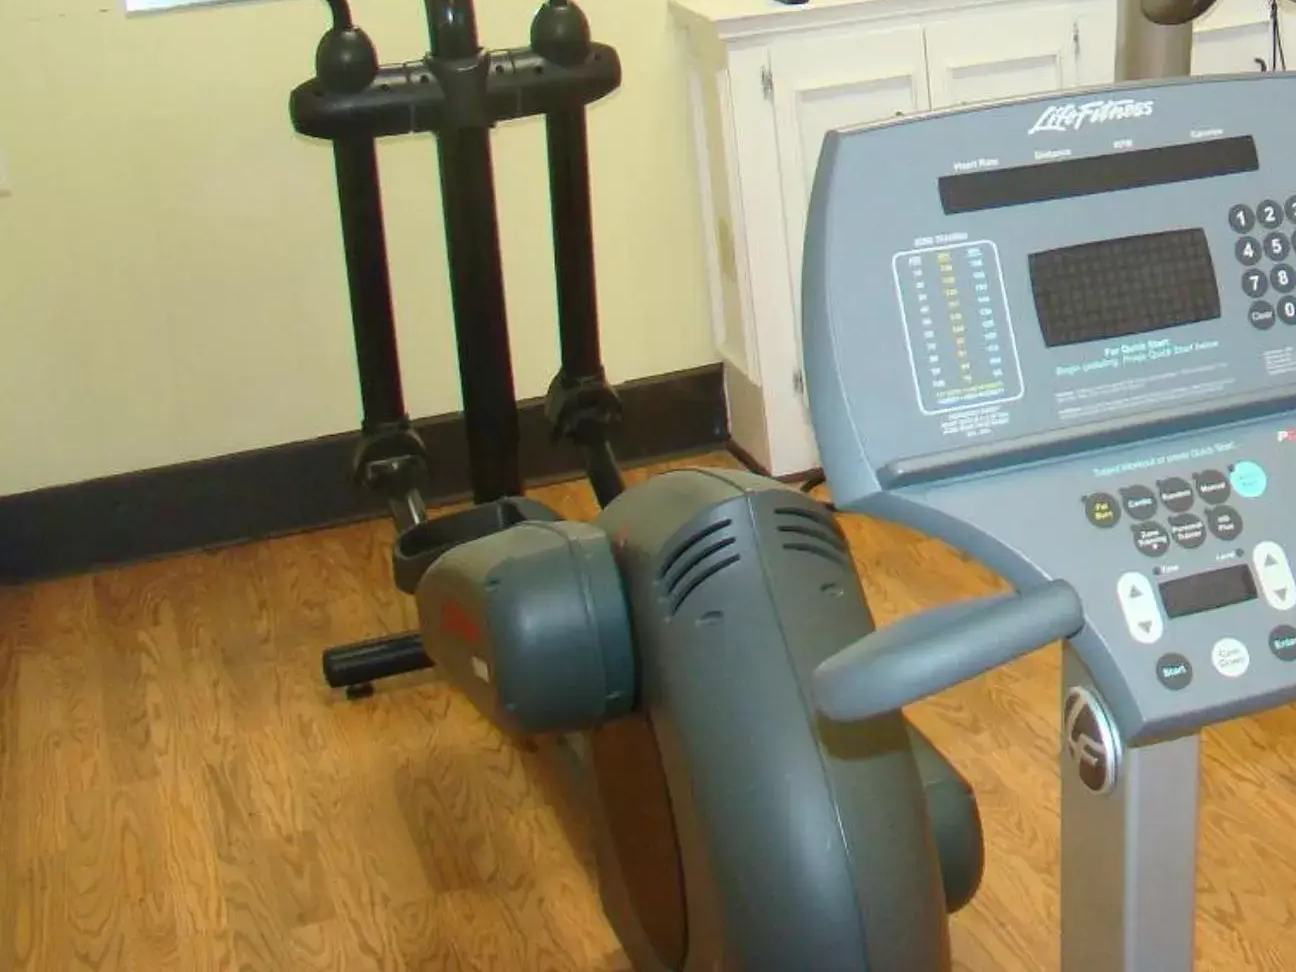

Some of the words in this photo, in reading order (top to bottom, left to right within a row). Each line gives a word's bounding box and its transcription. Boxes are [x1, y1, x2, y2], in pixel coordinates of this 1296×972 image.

[1236, 211, 1245, 226] 1
[1264, 206, 1276, 222] 2
[1243, 242, 1254, 258] 4
[1271, 238, 1282, 254] 5
[1249, 275, 1259, 291] 7
[1278, 270, 1289, 285] 8
[1284, 302, 1295, 317] 0
